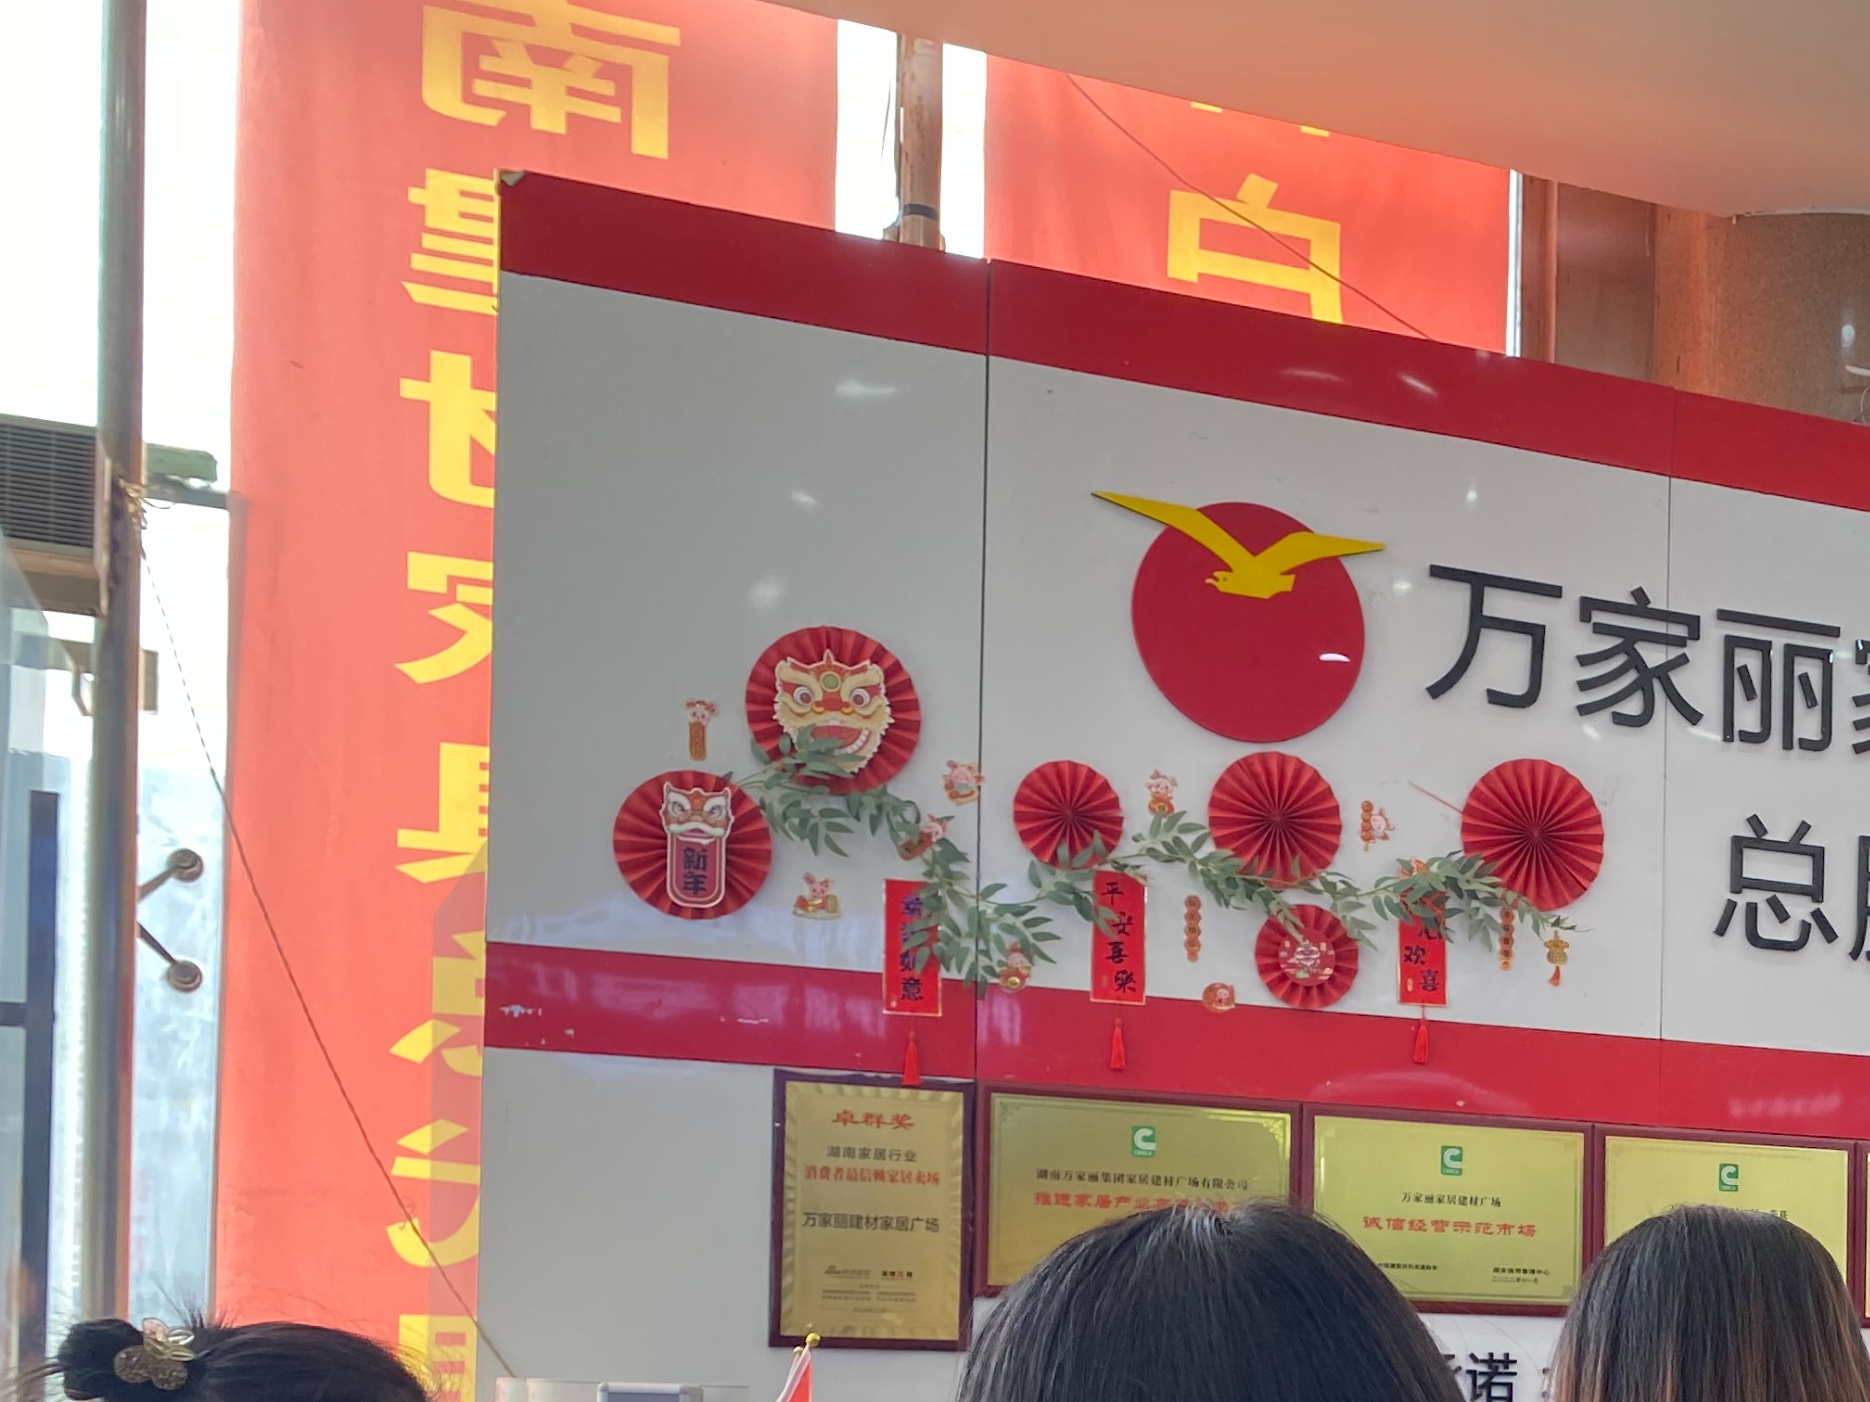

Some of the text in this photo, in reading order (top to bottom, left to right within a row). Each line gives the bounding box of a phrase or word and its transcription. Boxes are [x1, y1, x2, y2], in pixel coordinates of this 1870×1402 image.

[832, 1110, 915, 1130] 卓群奖
[827, 1145, 917, 1162] 湖南家居行业
[804, 1165, 941, 1186] 消费者最信赖家居卖场
[1036, 1168, 1248, 1191] 湖南万家丽集团家居建材广场有限公司
[1401, 1192, 1502, 1208] 万家丽家居建材广场
[802, 1212, 940, 1233] 万家丽建材家居广场
[1363, 1216, 1537, 1237] 诚信经营示范市场
